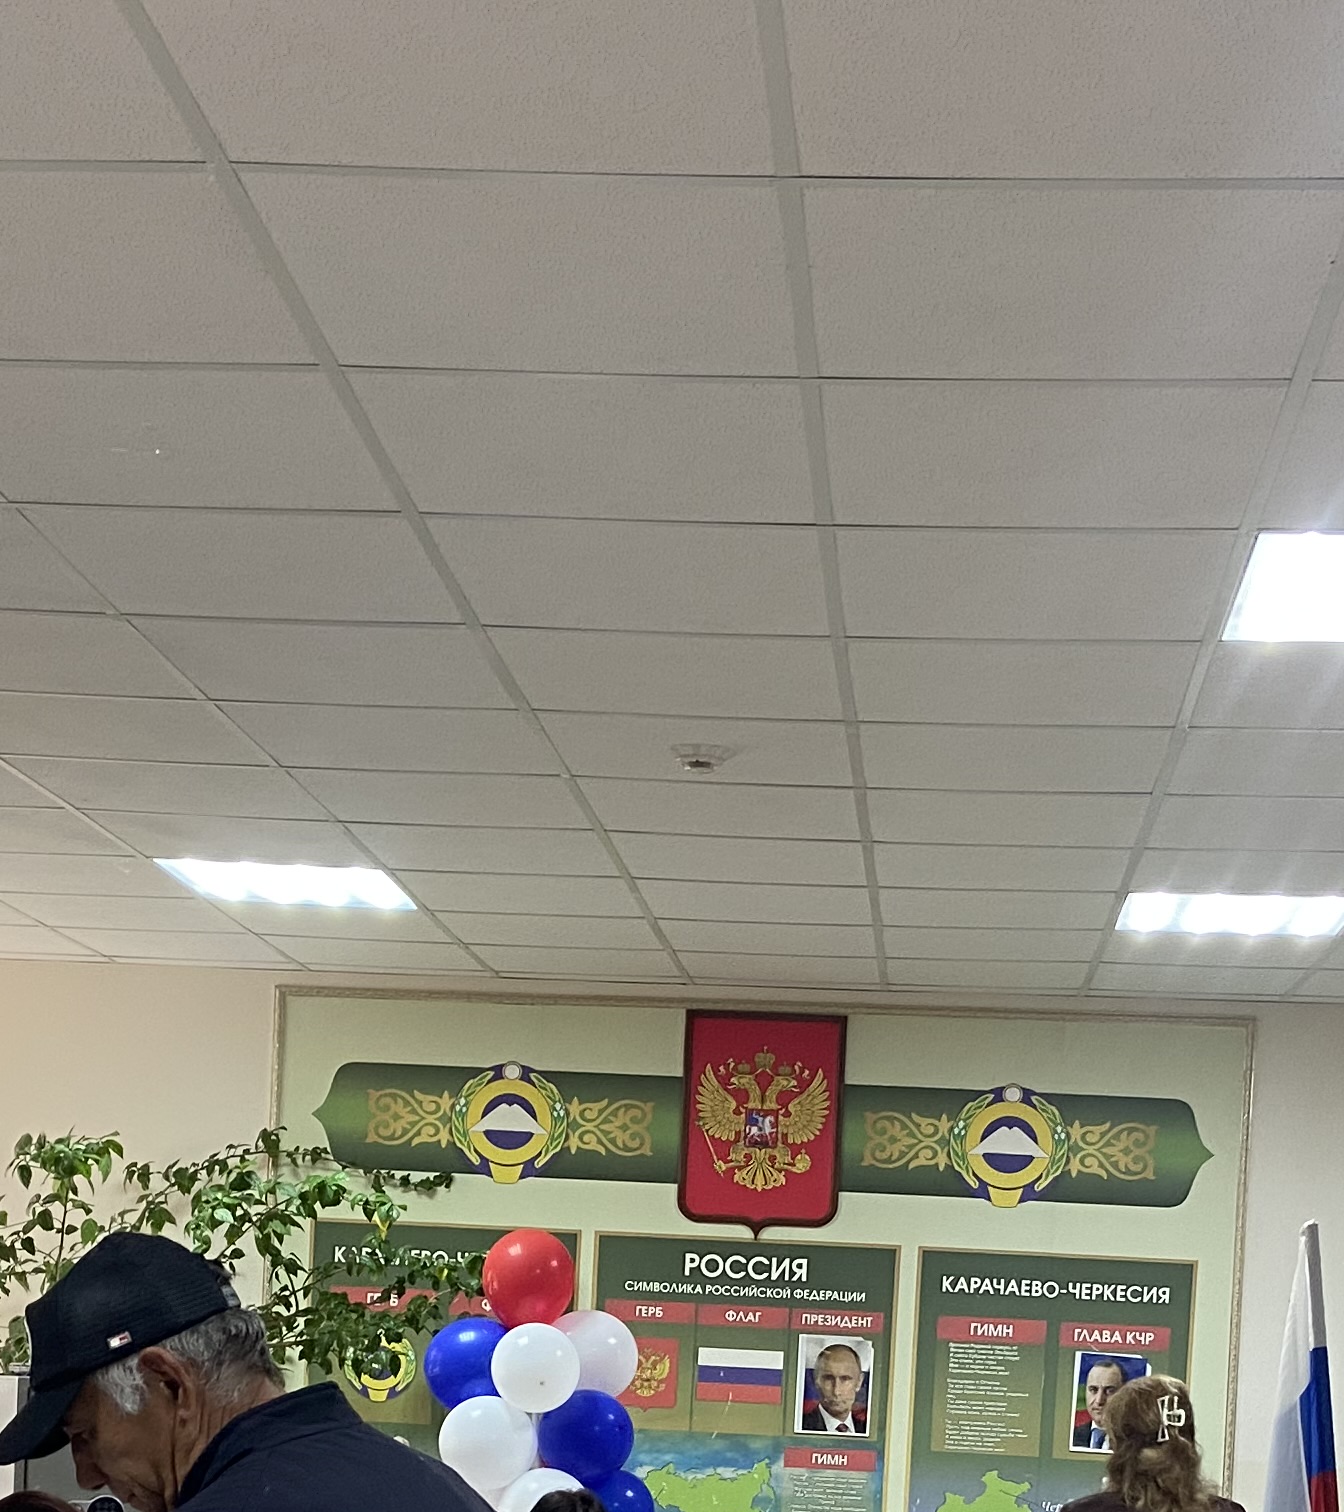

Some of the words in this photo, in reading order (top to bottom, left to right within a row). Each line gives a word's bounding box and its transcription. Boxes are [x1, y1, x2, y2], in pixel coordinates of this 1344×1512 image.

[683, 1252, 808, 1282] РОССИЯ
[624, 1280, 703, 1295] СИМВОЛИКА
[705, 1284, 791, 1299] РОССИЙСКОЙ
[793, 1288, 866, 1302] ФЕДЕРАЦИИ
[941, 1275, 1171, 1304] КАРАЧАЕВО-ЧЕРКЕСИЯ
[366, 1292, 399, 1307] ГЕБ
[635, 1305, 664, 1318] ГЕРБ
[725, 1309, 762, 1323] ФЛАГ
[801, 1313, 874, 1328] ПРЕЗИДЕНТ
[969, 1322, 1014, 1337] ГИМН
[1073, 1328, 1122, 1344] ГЛАВА
[1126, 1331, 1155, 1346] КЧР
[811, 1453, 848, 1466] ГИМН
